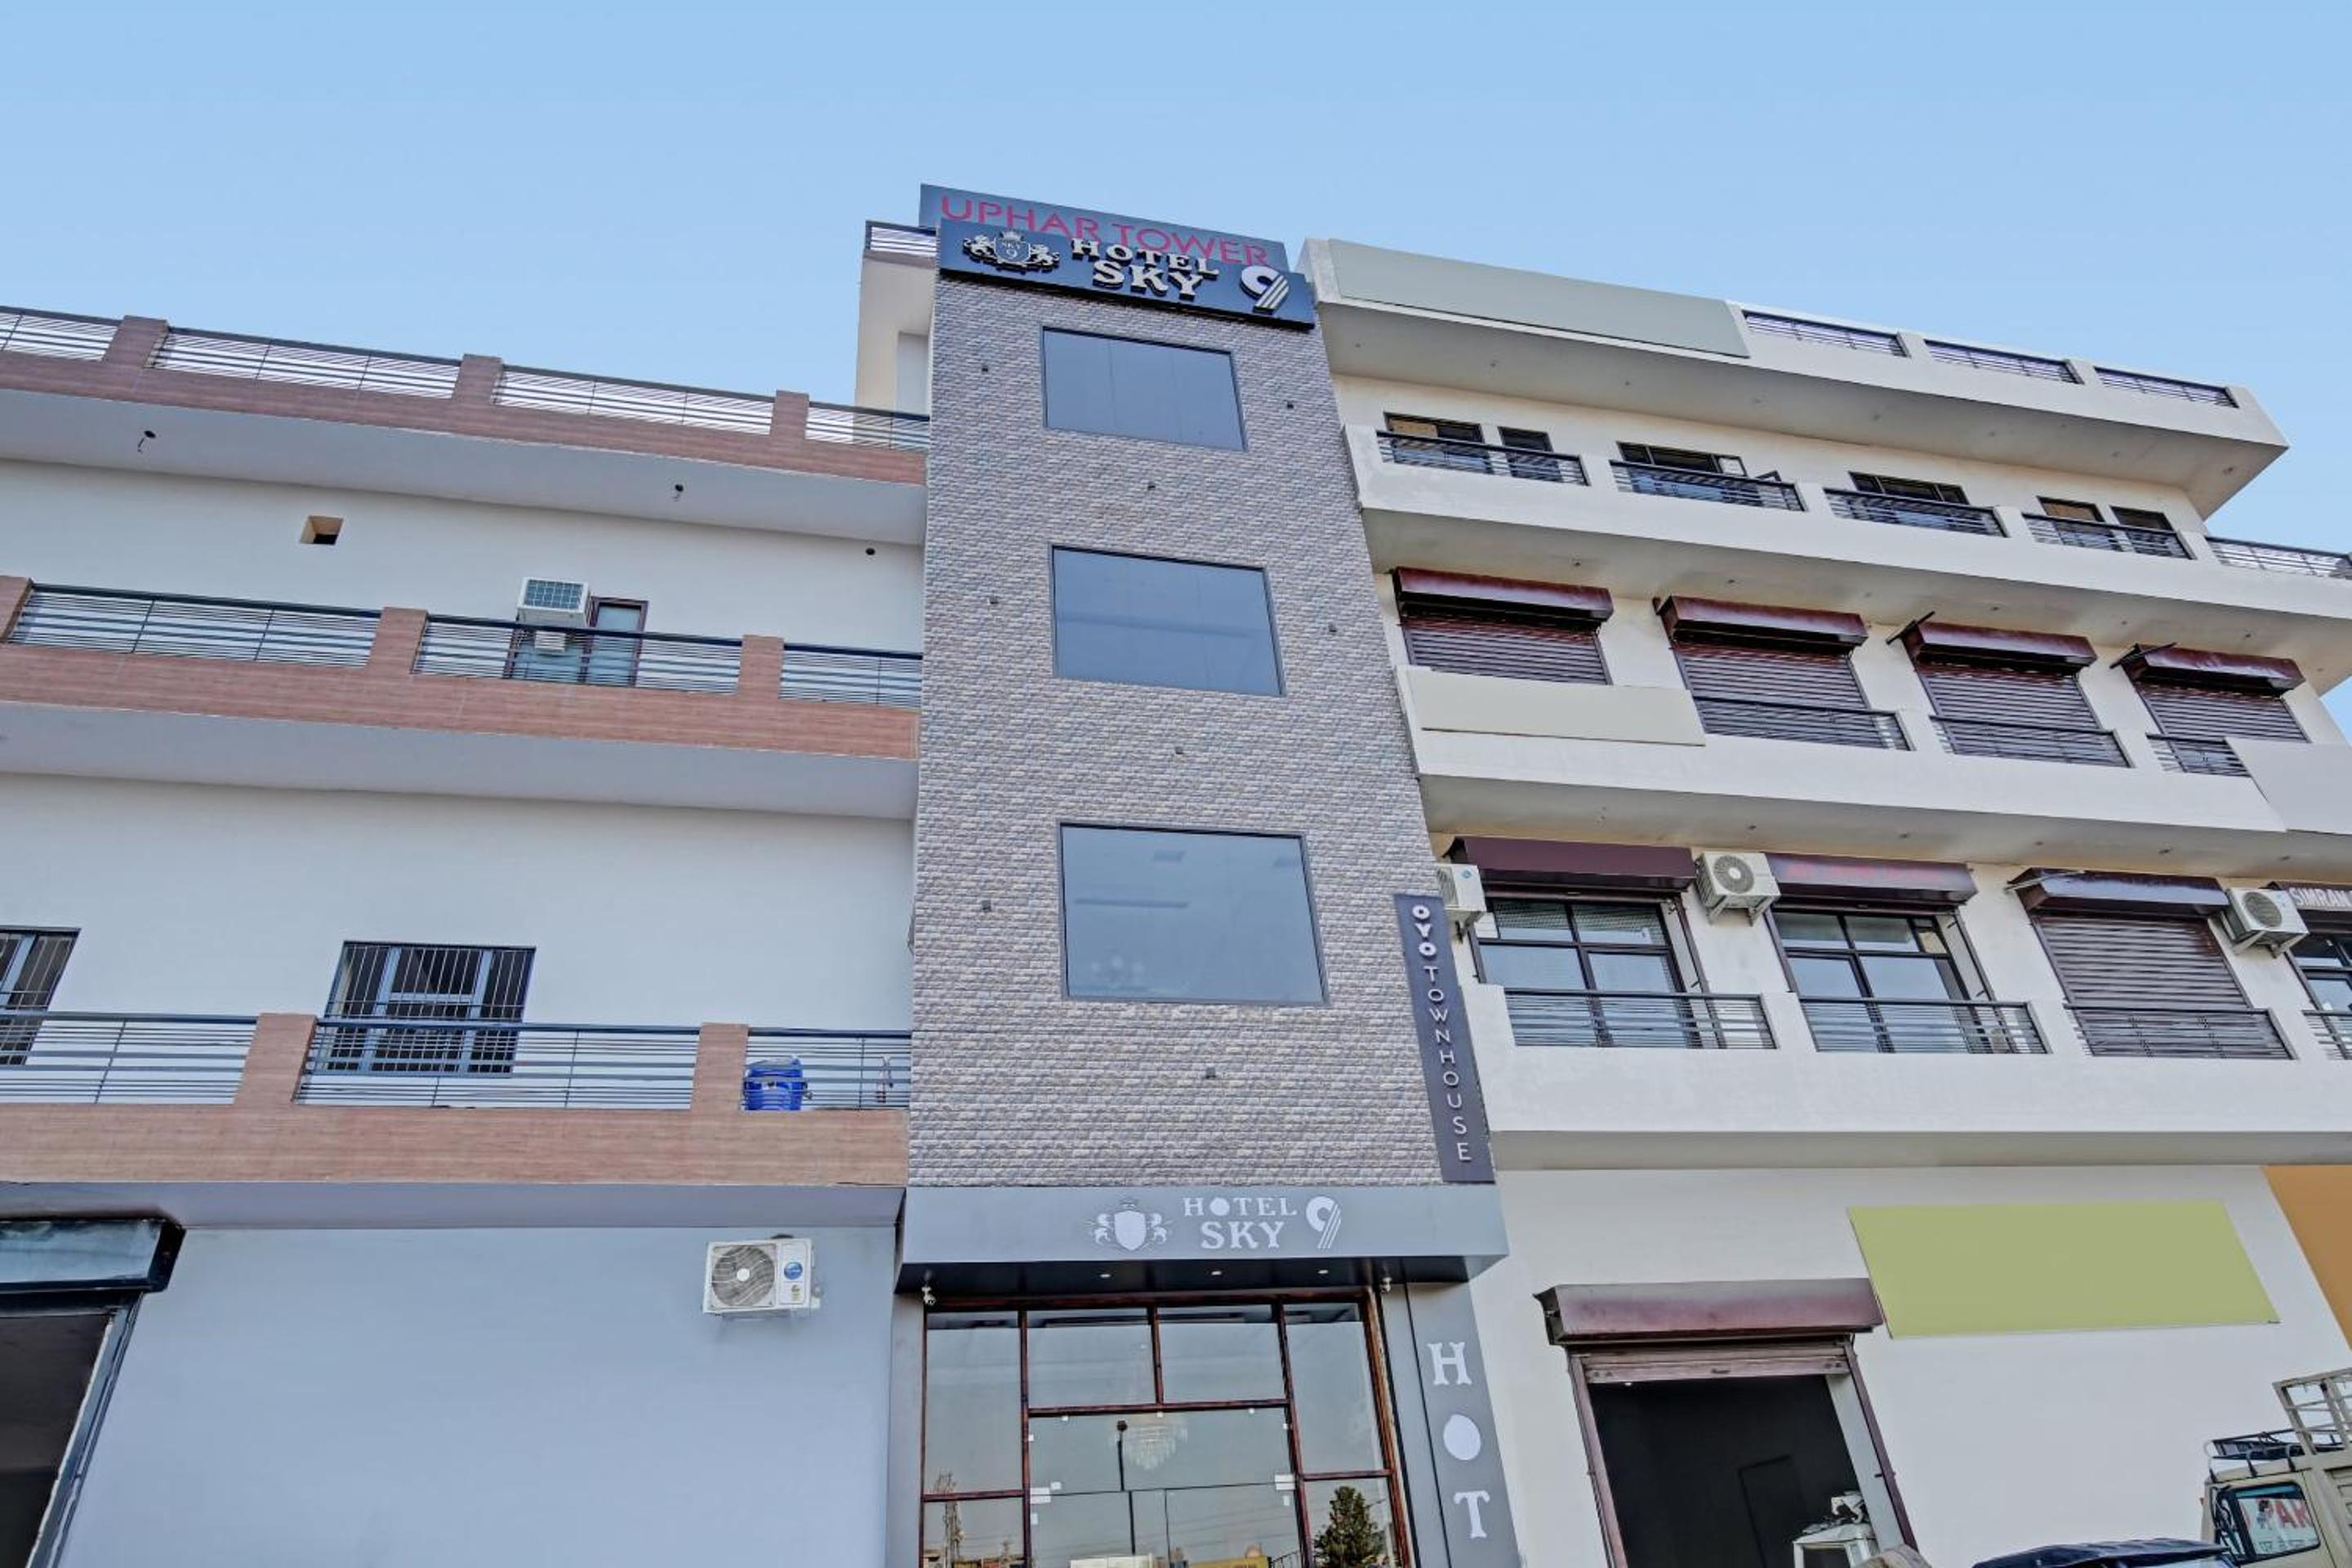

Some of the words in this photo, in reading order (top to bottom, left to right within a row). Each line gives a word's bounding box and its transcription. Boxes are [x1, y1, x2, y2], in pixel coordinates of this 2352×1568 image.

[940, 195, 1100, 241] UPHAR
[1108, 222, 1268, 265] TOWER
[1072, 238, 1219, 274] HOTEL
[1094, 260, 1204, 300] SKY
[1241, 266, 1290, 313] 9
[1412, 904, 1437, 960] OYO
[1423, 965, 1471, 1161] TOWNHOUSE
[1184, 1197, 1297, 1216] HOTEL
[1201, 1222, 1284, 1249] SKY
[1307, 1196, 1341, 1249] 9
